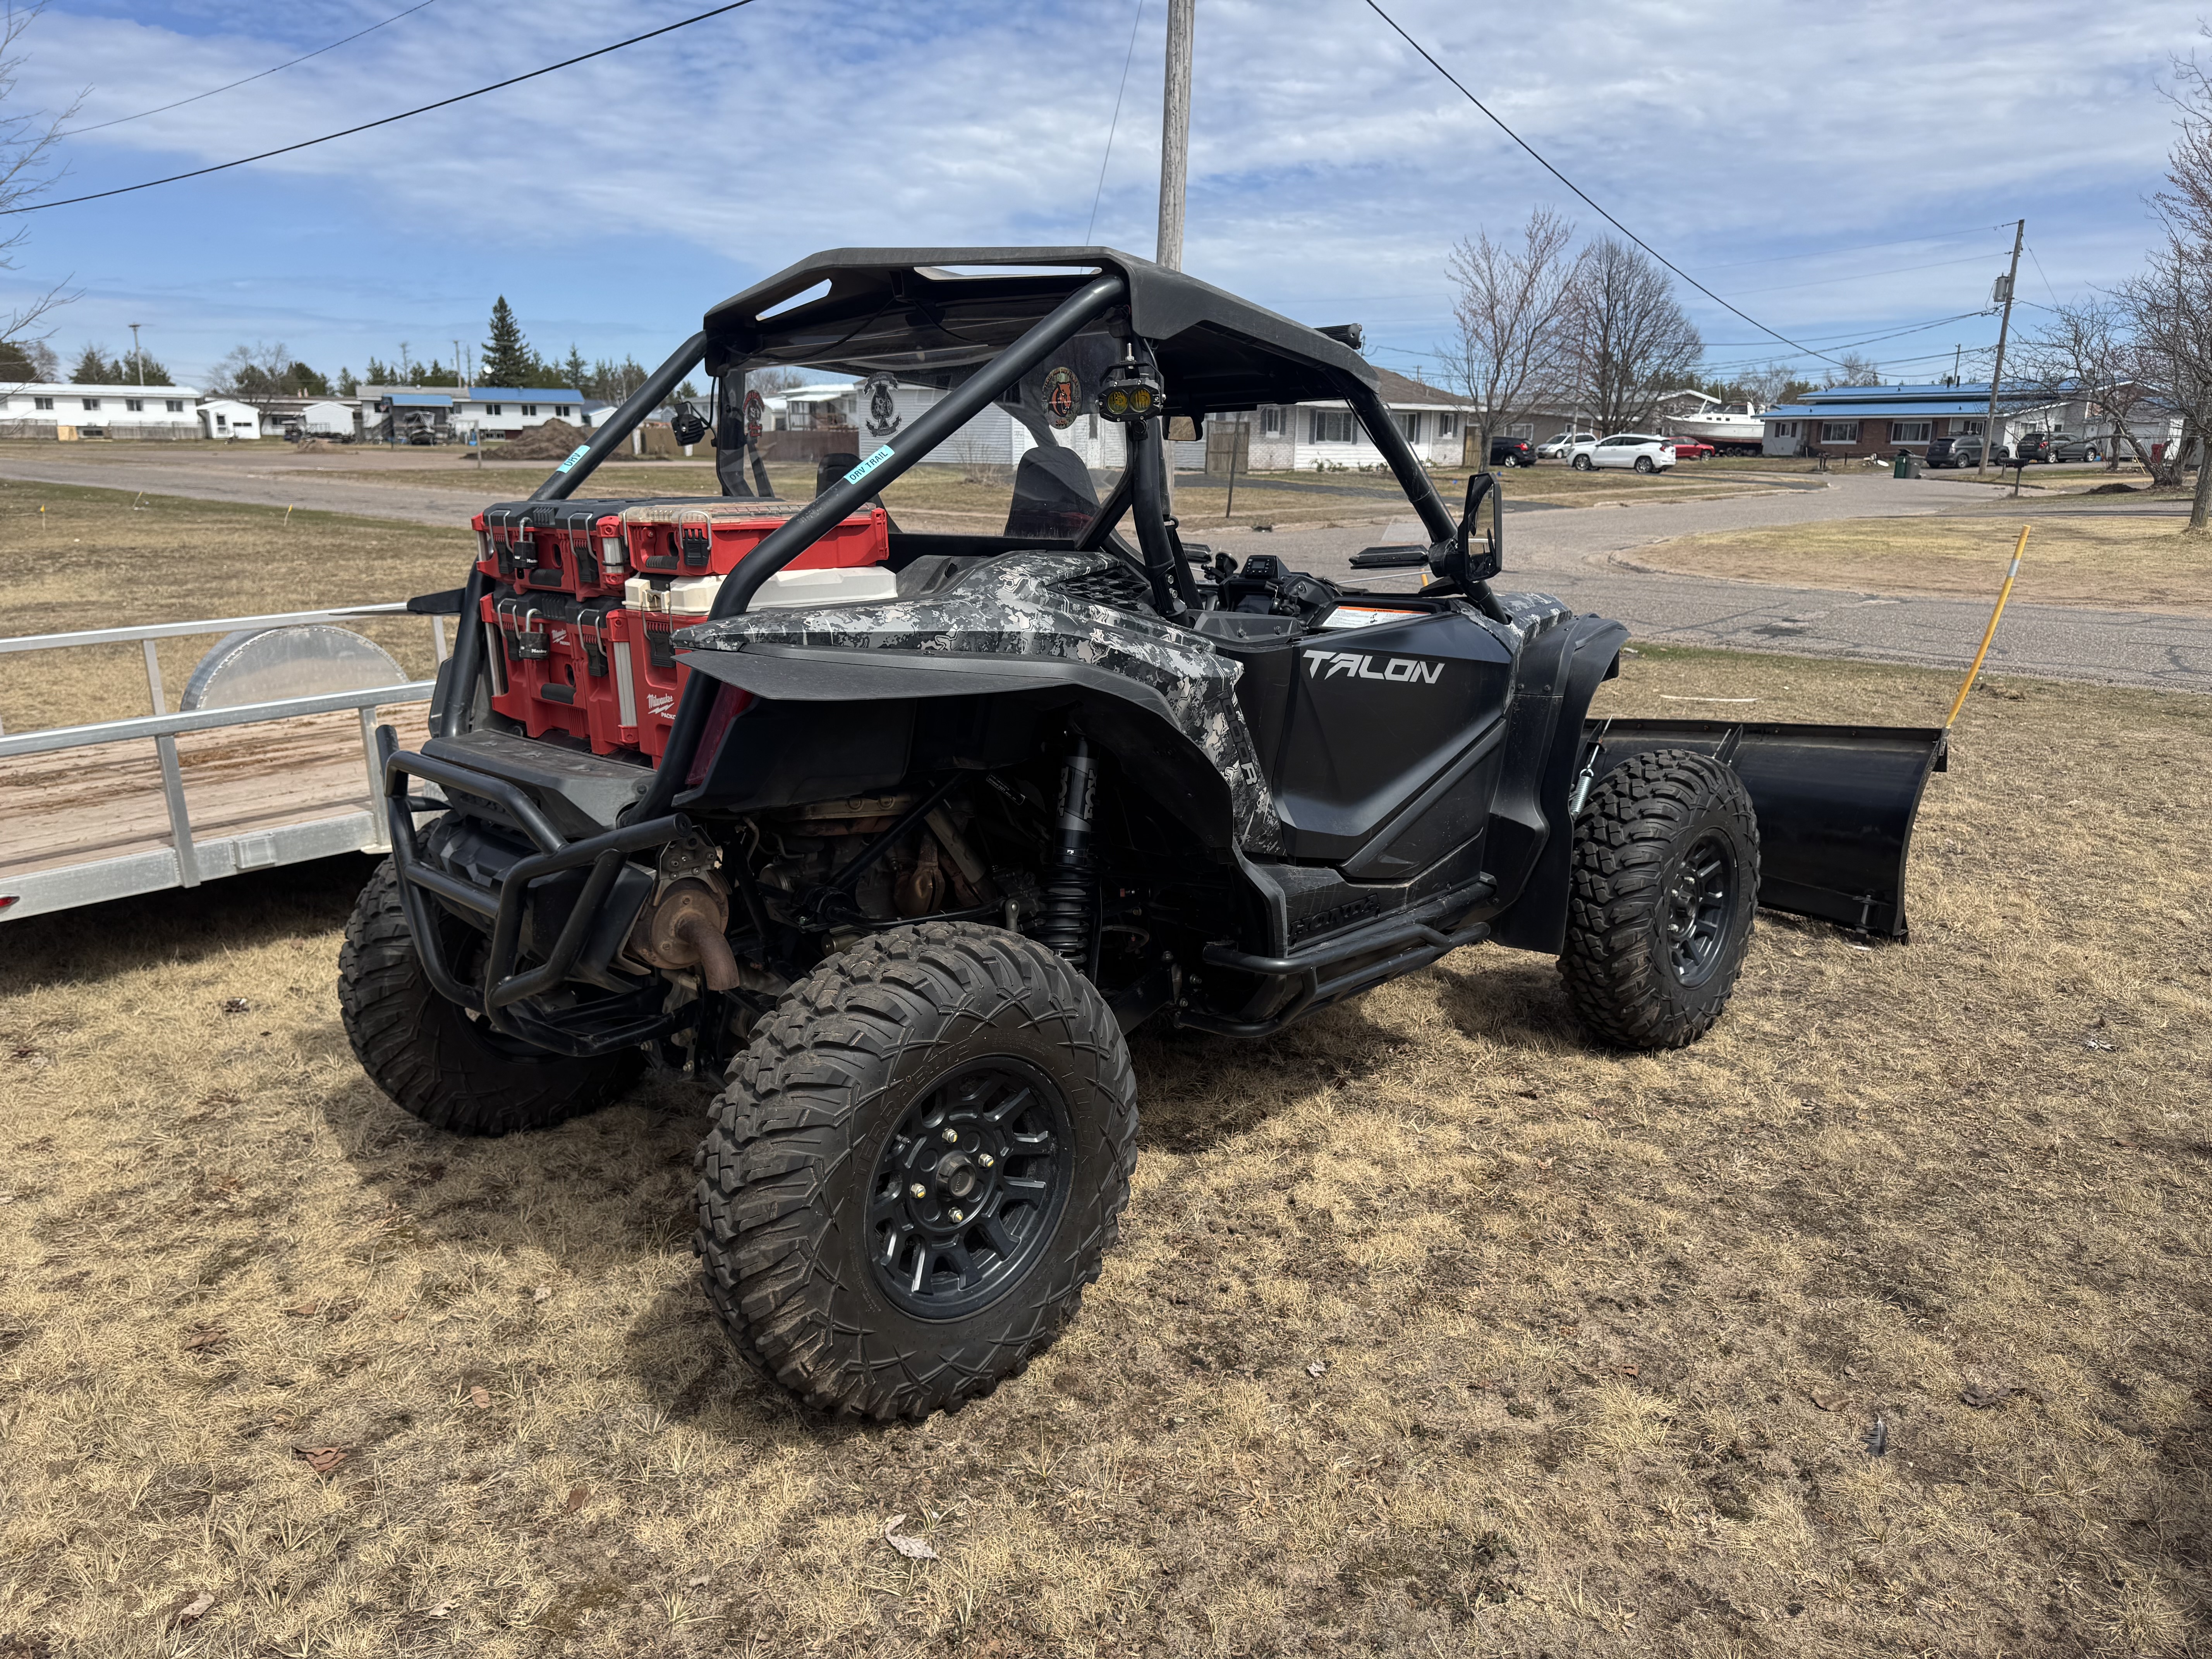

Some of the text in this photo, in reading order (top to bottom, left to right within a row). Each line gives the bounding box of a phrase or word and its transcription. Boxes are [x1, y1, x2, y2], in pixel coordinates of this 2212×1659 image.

[563, 453, 581, 466] ORV
[849, 452, 888, 481] ORV TRAIL
[1303, 649, 1445, 684] TALON
[646, 693, 674, 709] Milwaukee
[1287, 893, 1381, 946] HONDA
[853, 1038, 971, 1180] TERRABITE
